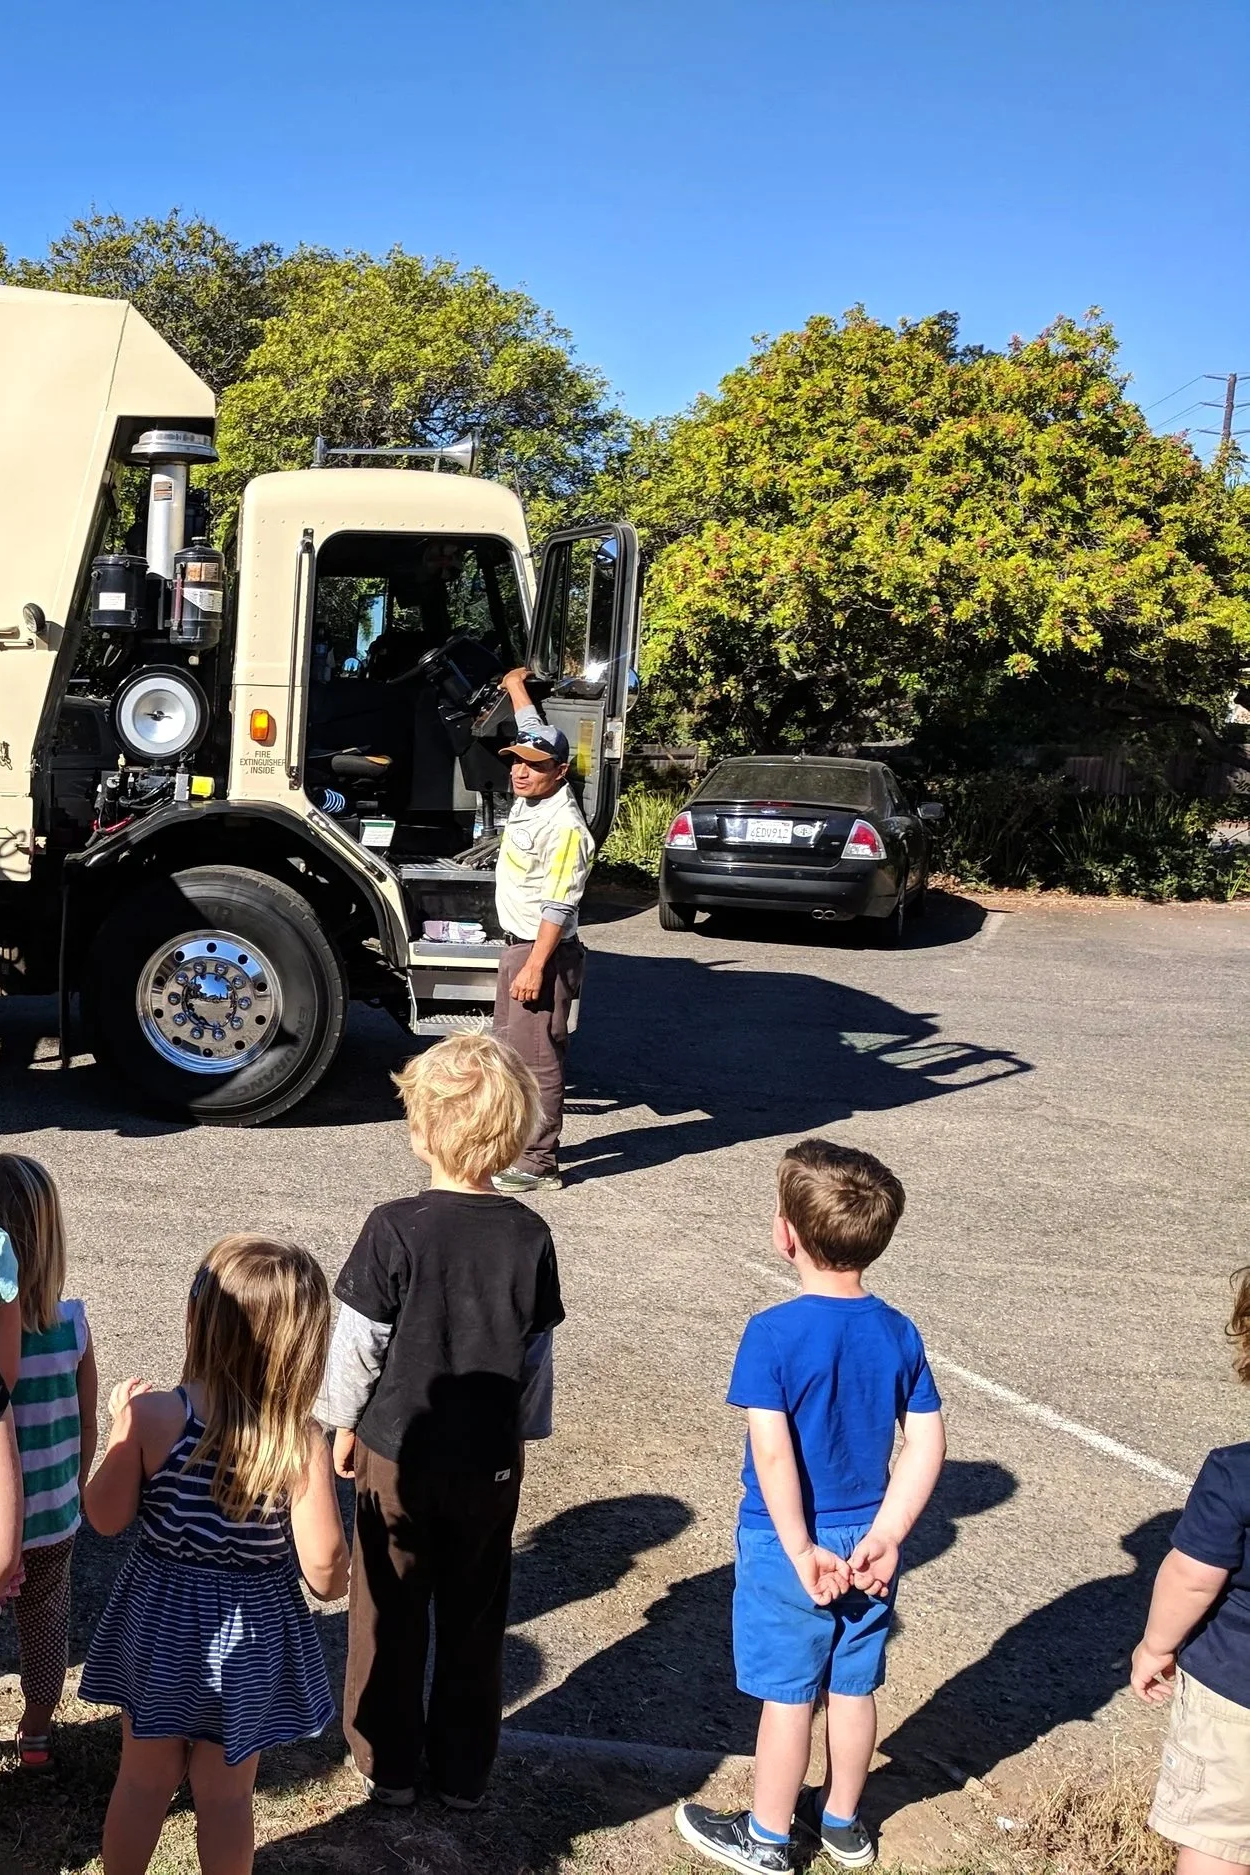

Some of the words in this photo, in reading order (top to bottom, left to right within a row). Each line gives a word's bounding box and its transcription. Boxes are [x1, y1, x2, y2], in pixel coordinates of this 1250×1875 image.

[255, 750, 271, 758] FIRE
[240, 758, 286, 766] EXTINGUISHER
[250, 766, 275, 774] INSIDE
[225, 1006, 308, 1097] ENURANCE
